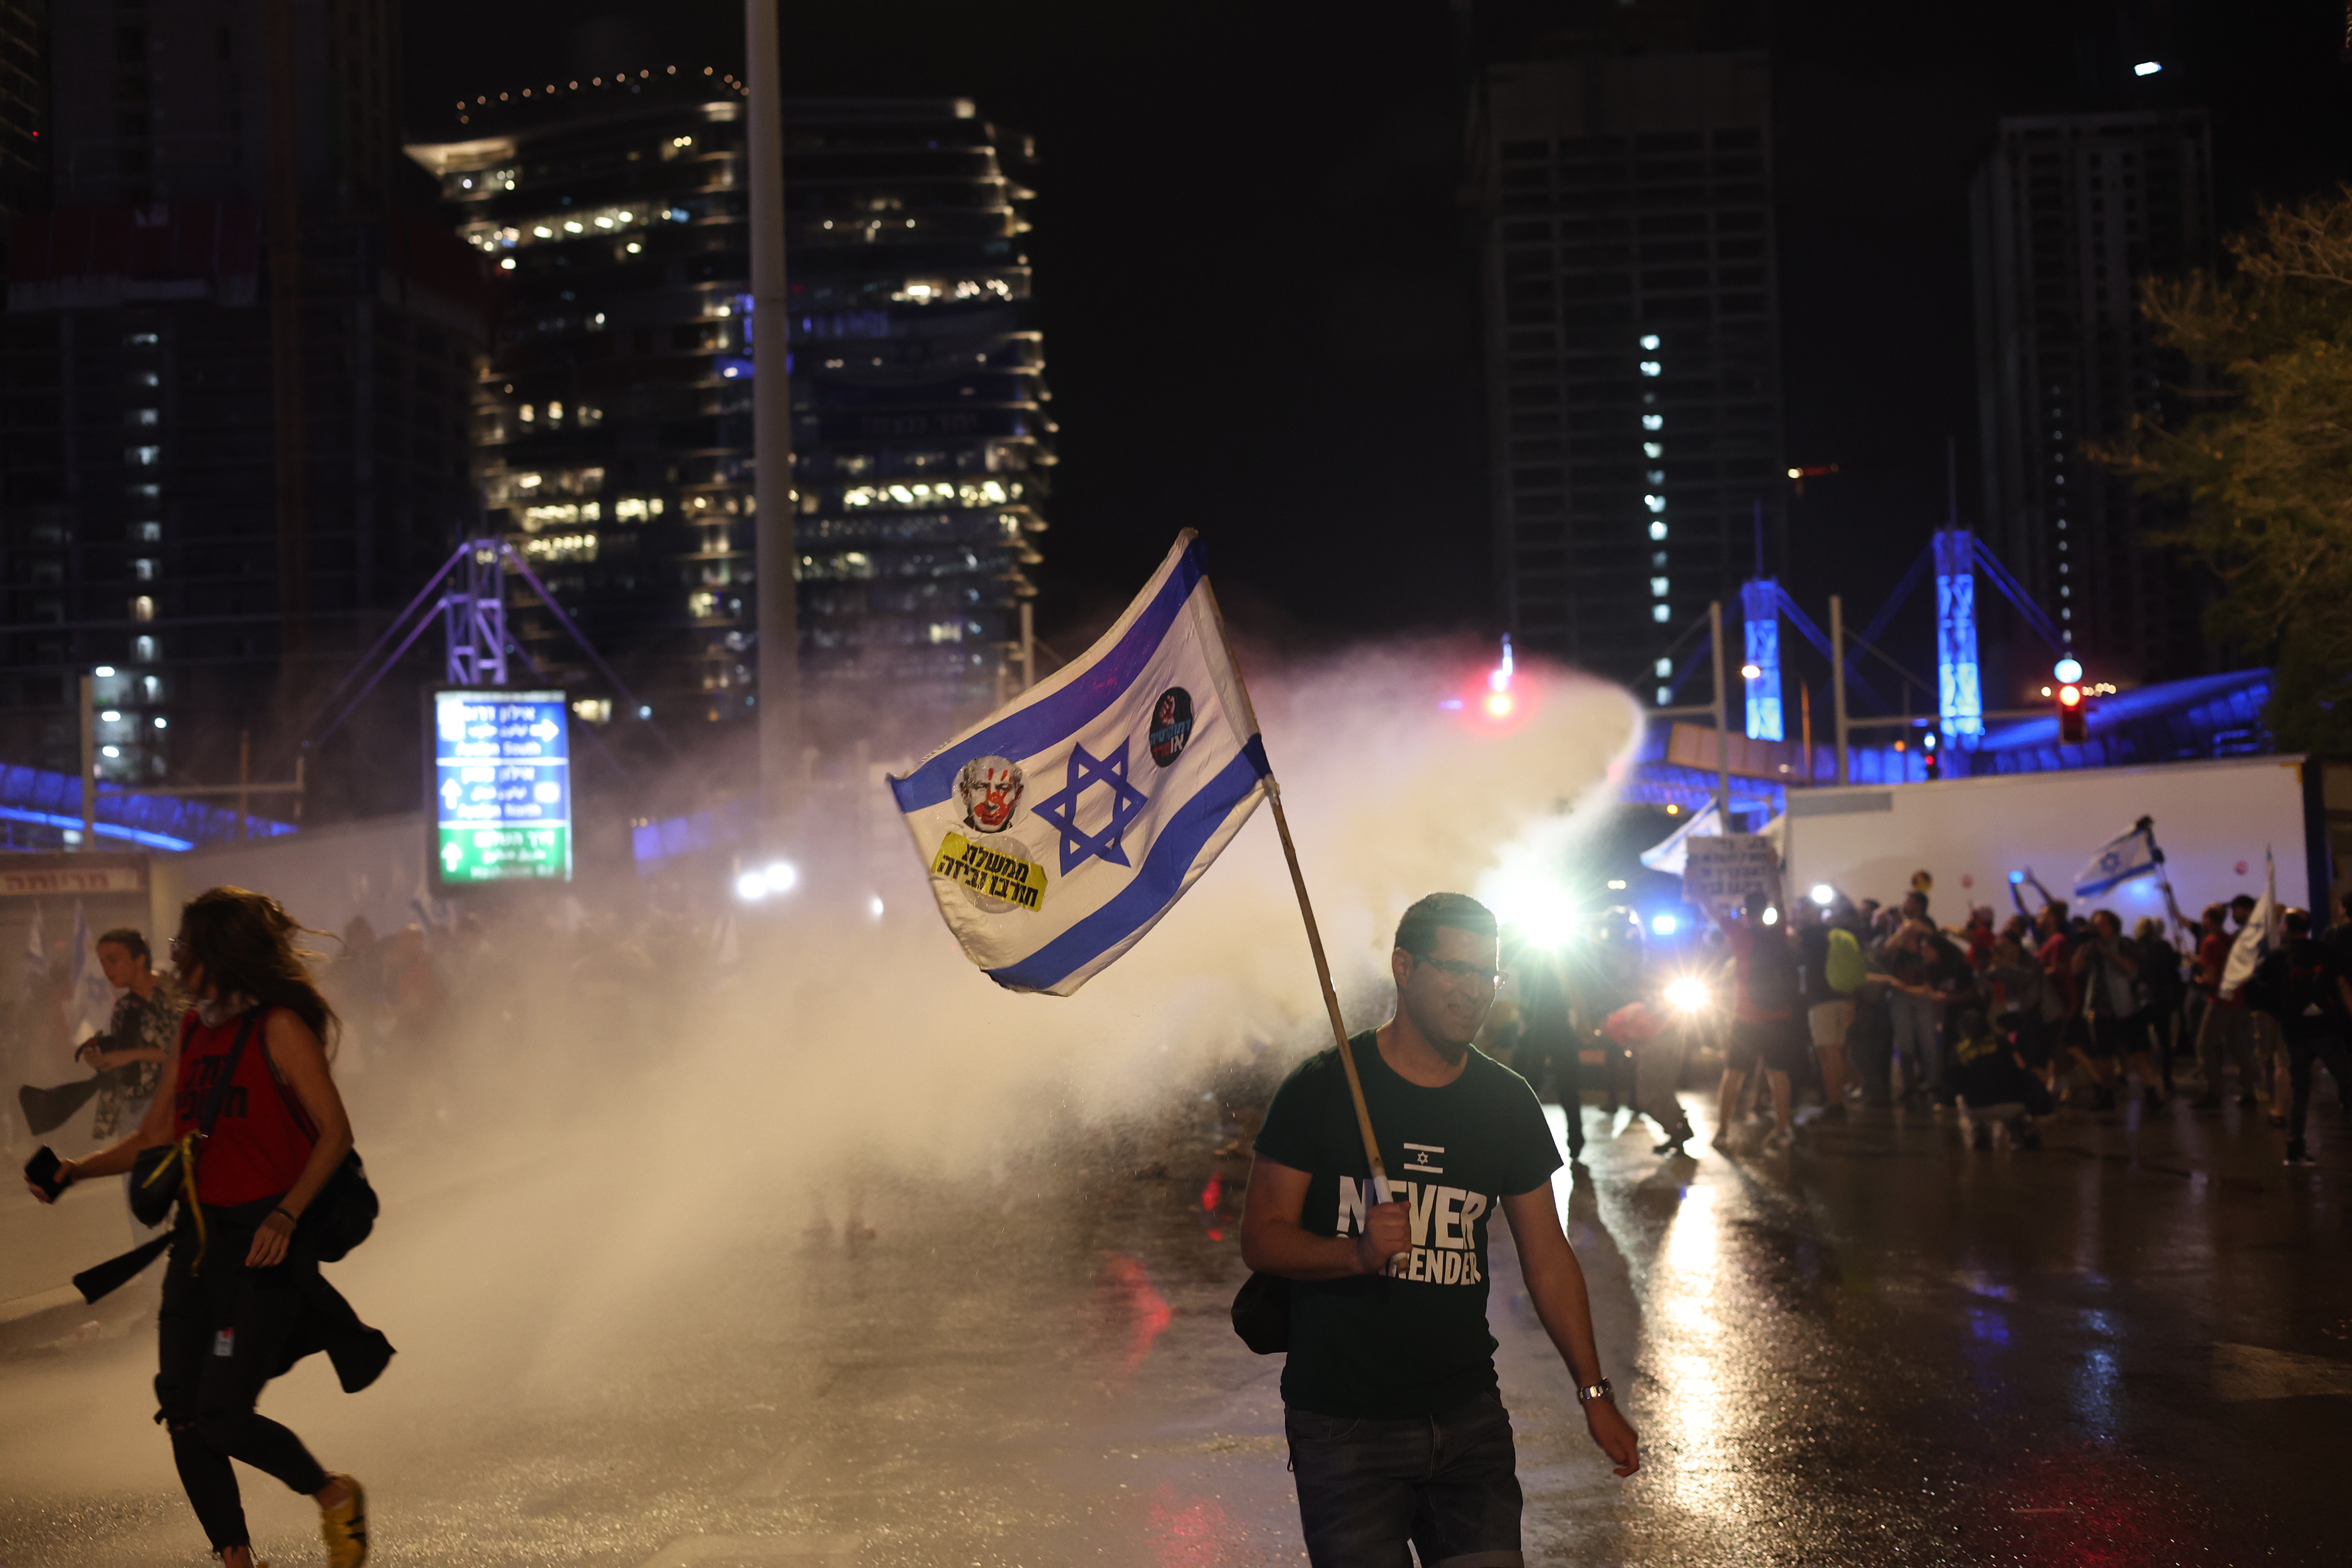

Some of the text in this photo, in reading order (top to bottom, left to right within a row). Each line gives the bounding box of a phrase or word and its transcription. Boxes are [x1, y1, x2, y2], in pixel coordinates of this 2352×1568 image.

[1171, 733, 1183, 753] או
[937, 855, 1038, 907] חורבן וביזה
[962, 844, 1029, 883] ממשלת
[1337, 1176, 1487, 1250] NVER
